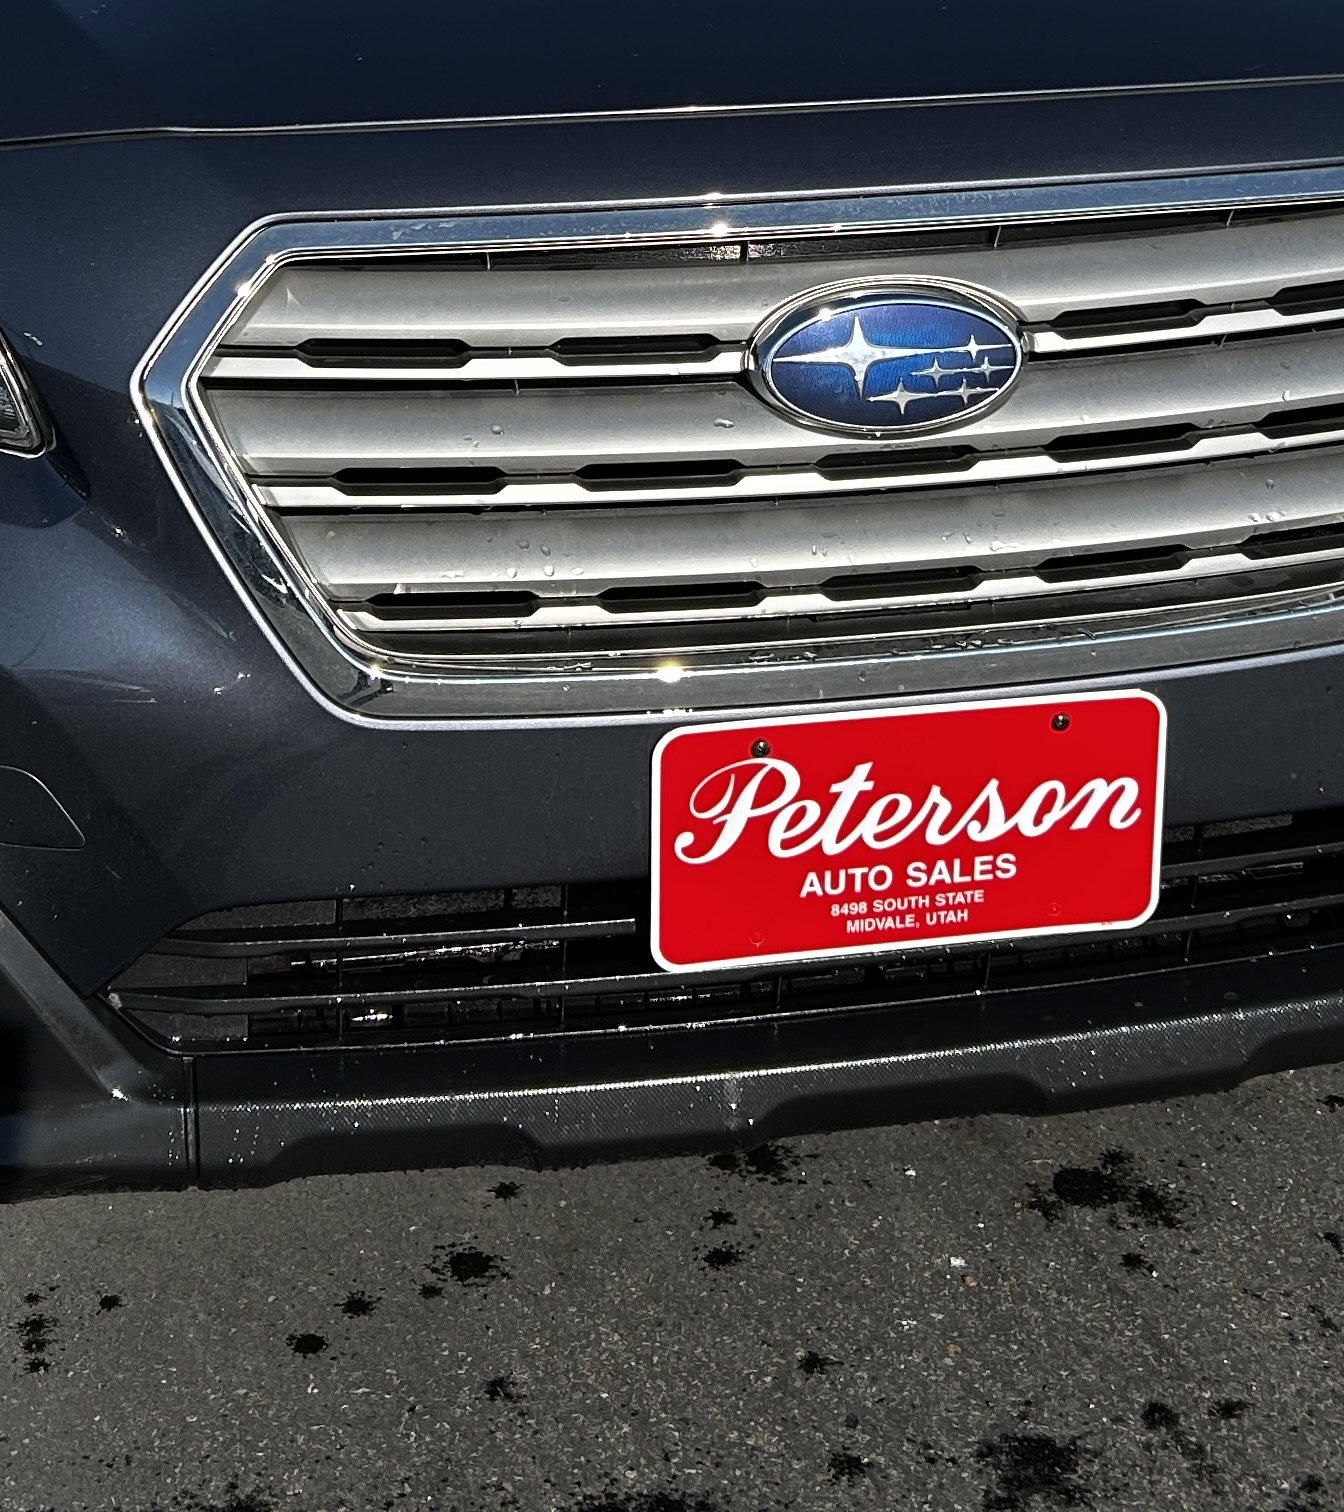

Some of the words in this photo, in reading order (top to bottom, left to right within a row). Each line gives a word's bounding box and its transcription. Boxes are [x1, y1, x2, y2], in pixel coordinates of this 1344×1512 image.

[674, 756, 1142, 865] Peterson
[799, 868, 894, 899] AUTO
[905, 852, 1018, 888] SALES
[830, 900, 868, 918] 8498
[872, 894, 930, 913] SOUTH
[935, 889, 985, 907] STATE
[846, 912, 921, 934] MIDVALE,
[926, 908, 969, 926] UTAH
